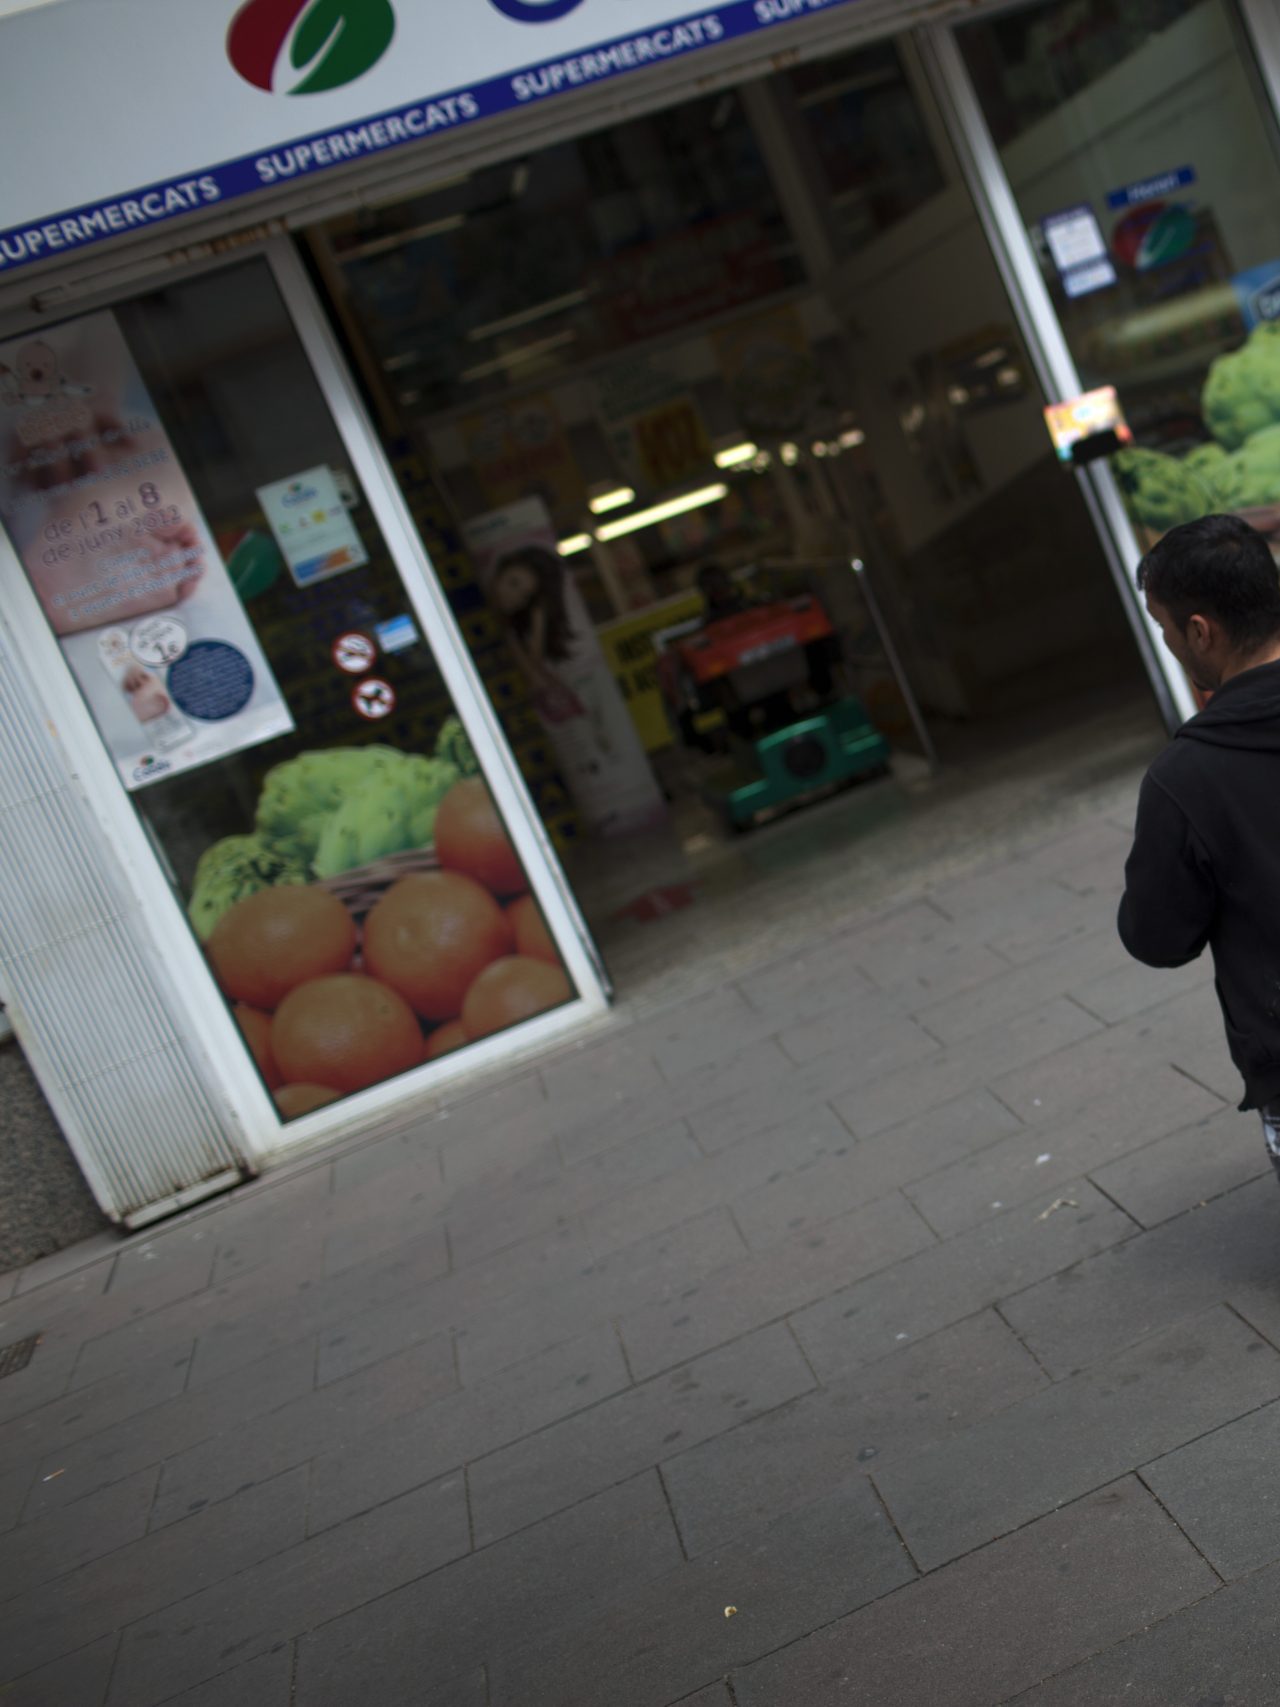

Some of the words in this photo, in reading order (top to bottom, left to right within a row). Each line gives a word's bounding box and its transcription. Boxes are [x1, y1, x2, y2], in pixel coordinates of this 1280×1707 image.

[256, 92, 479, 183] SUPERMERCATS
[511, 14, 724, 101] SUPERMERCATS
[42, 543, 71, 567] de
[75, 526, 123, 556] juny
[130, 504, 182, 536] 2012
[44, 518, 73, 543] de
[114, 496, 137, 520] al
[138, 481, 161, 509] 8
